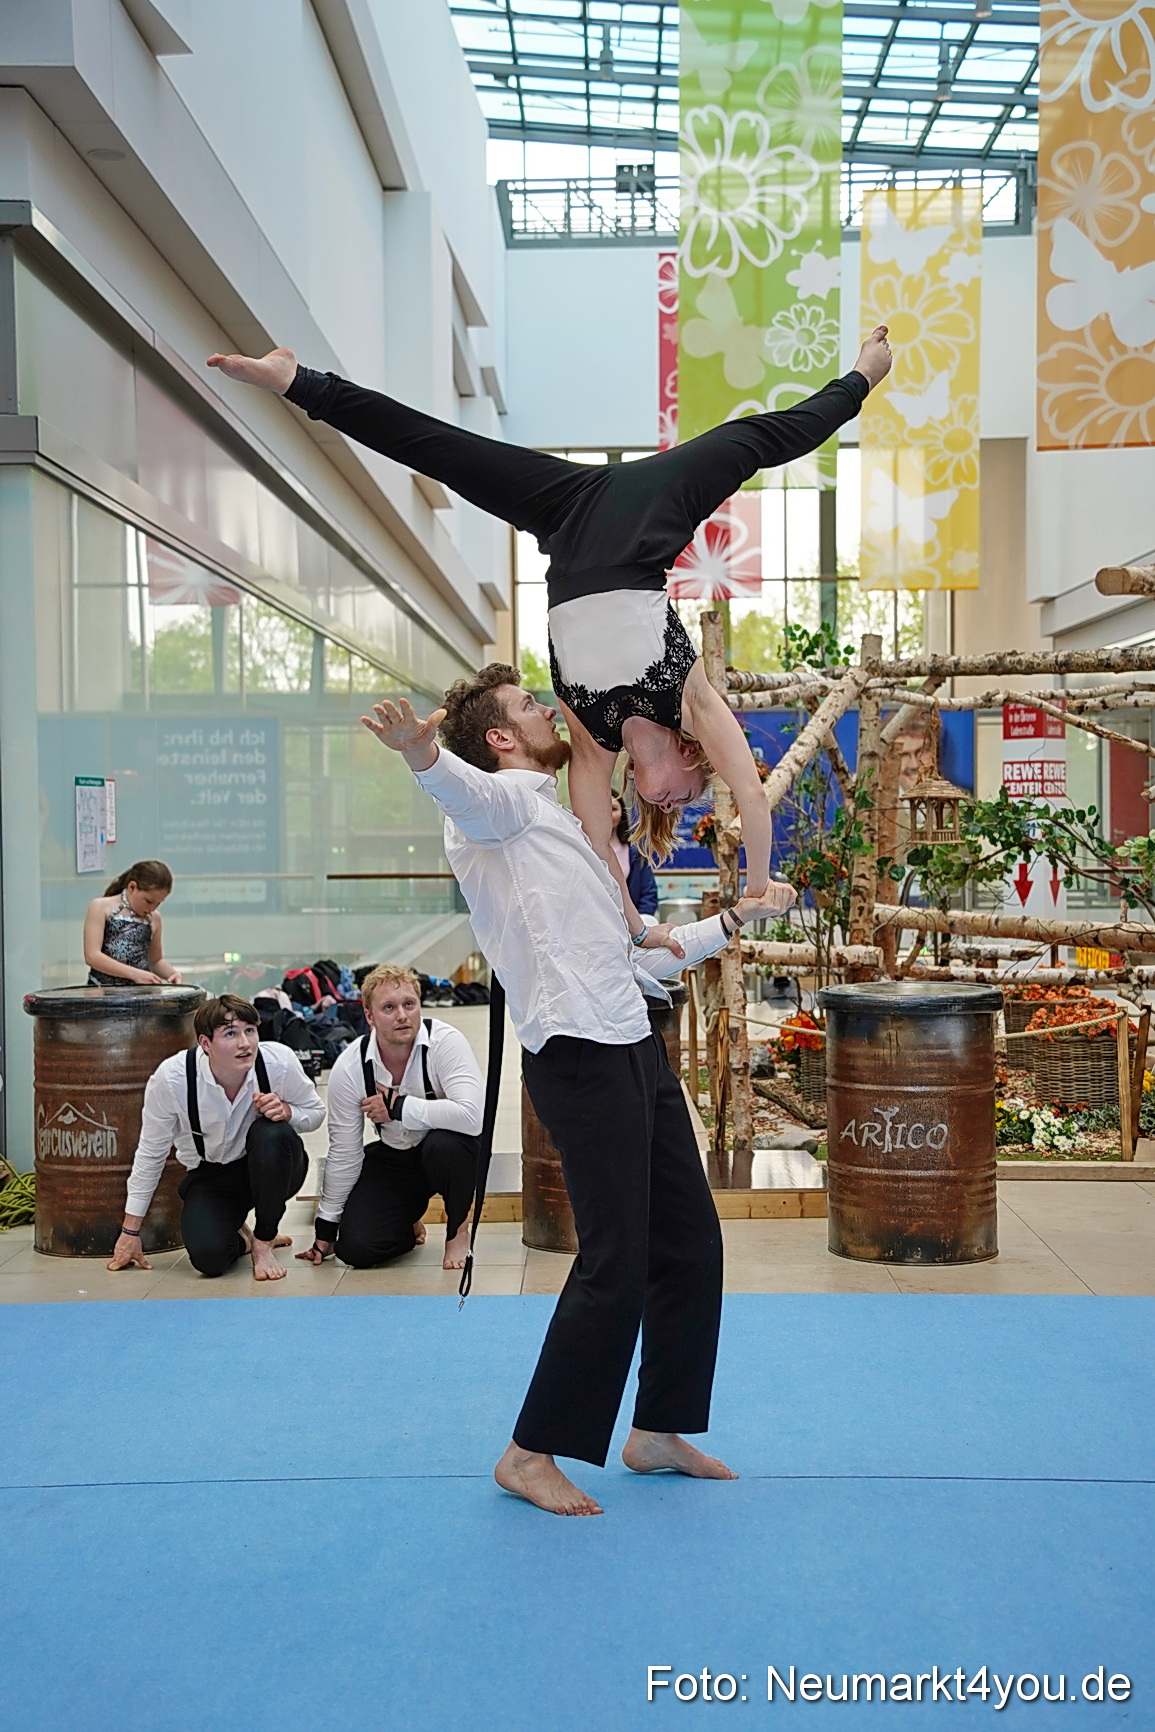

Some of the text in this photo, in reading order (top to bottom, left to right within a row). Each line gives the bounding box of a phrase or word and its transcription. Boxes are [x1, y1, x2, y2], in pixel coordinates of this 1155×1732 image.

[1004, 762, 1042, 780] REWE
[1044, 762, 1066, 780] REWE
[1004, 782, 1042, 795] CENTER
[1044, 782, 1066, 795] CENTER
